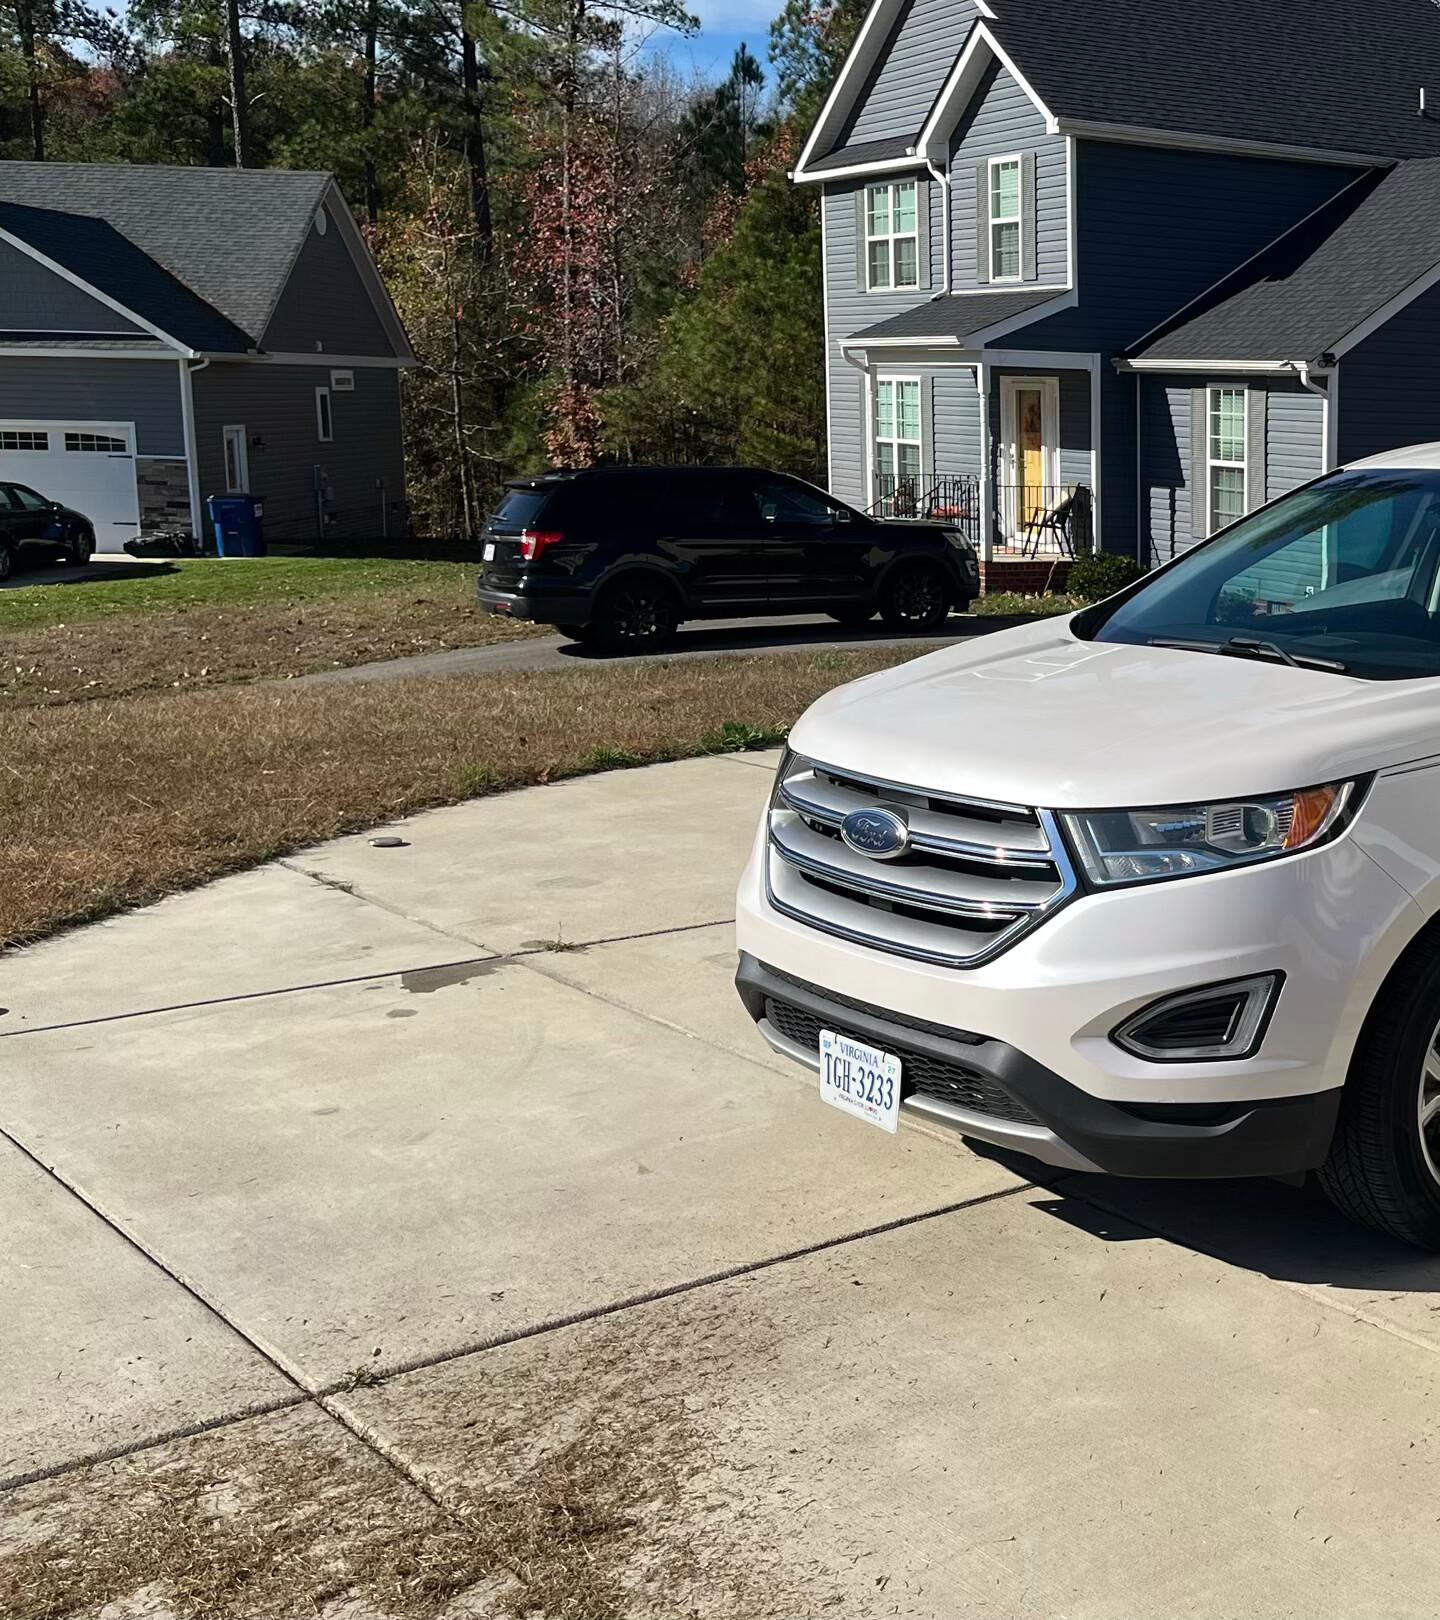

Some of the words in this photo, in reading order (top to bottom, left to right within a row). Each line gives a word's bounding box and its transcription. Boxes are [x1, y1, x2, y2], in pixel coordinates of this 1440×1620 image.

[851, 817, 888, 847] Ford
[840, 1042, 879, 1068] VIRGINIA
[824, 1052, 893, 1110] TGH-3233
